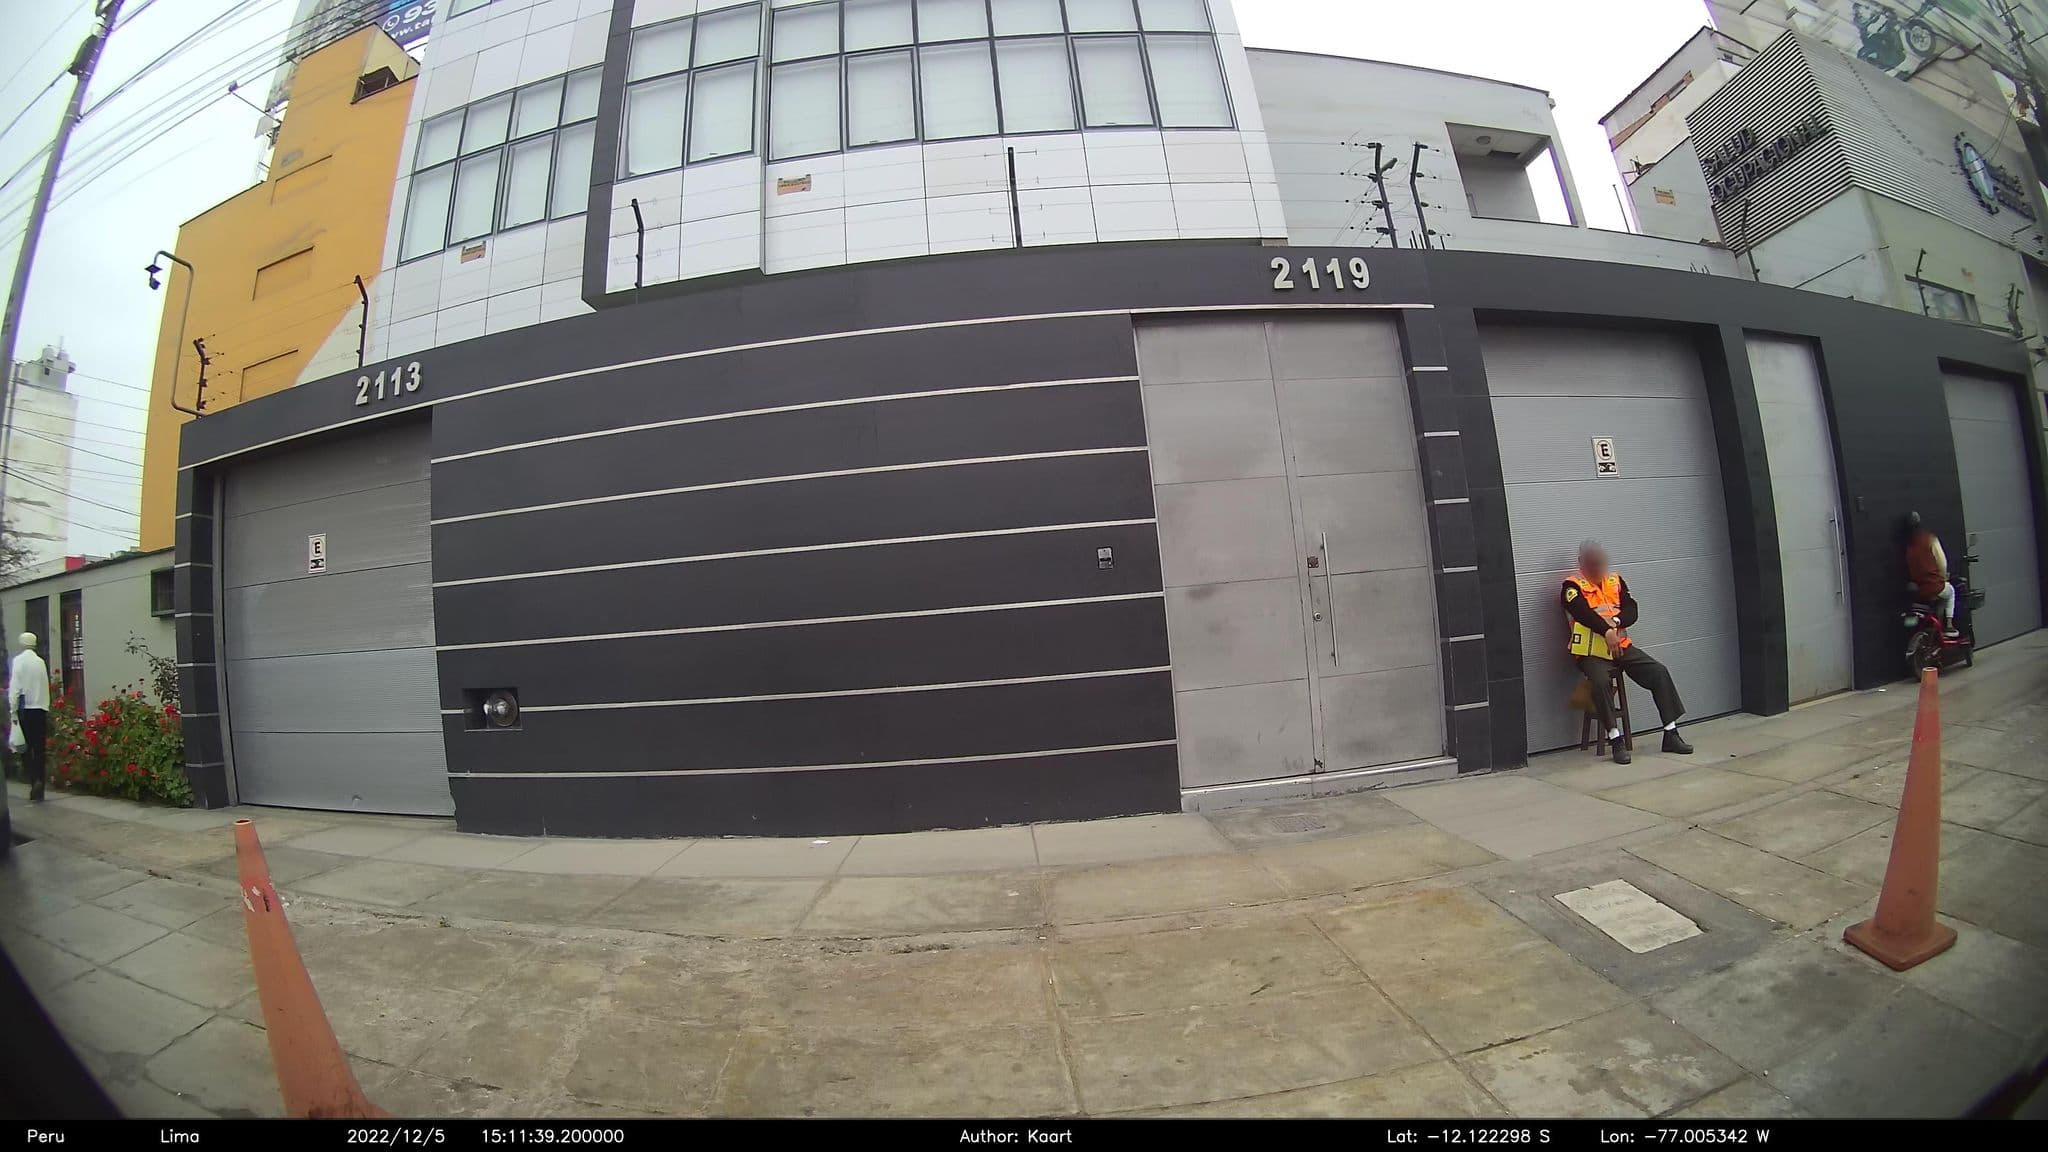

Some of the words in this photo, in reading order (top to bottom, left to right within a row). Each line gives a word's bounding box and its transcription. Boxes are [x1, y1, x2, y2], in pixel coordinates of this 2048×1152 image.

[1701, 126, 1757, 176] SALUD
[1712, 115, 1827, 201] OCUPACIONAL
[1271, 257, 1370, 289] 2119
[355, 361, 421, 406] 2113
[1600, 443, 1610, 457] E
[314, 541, 322, 554] E
